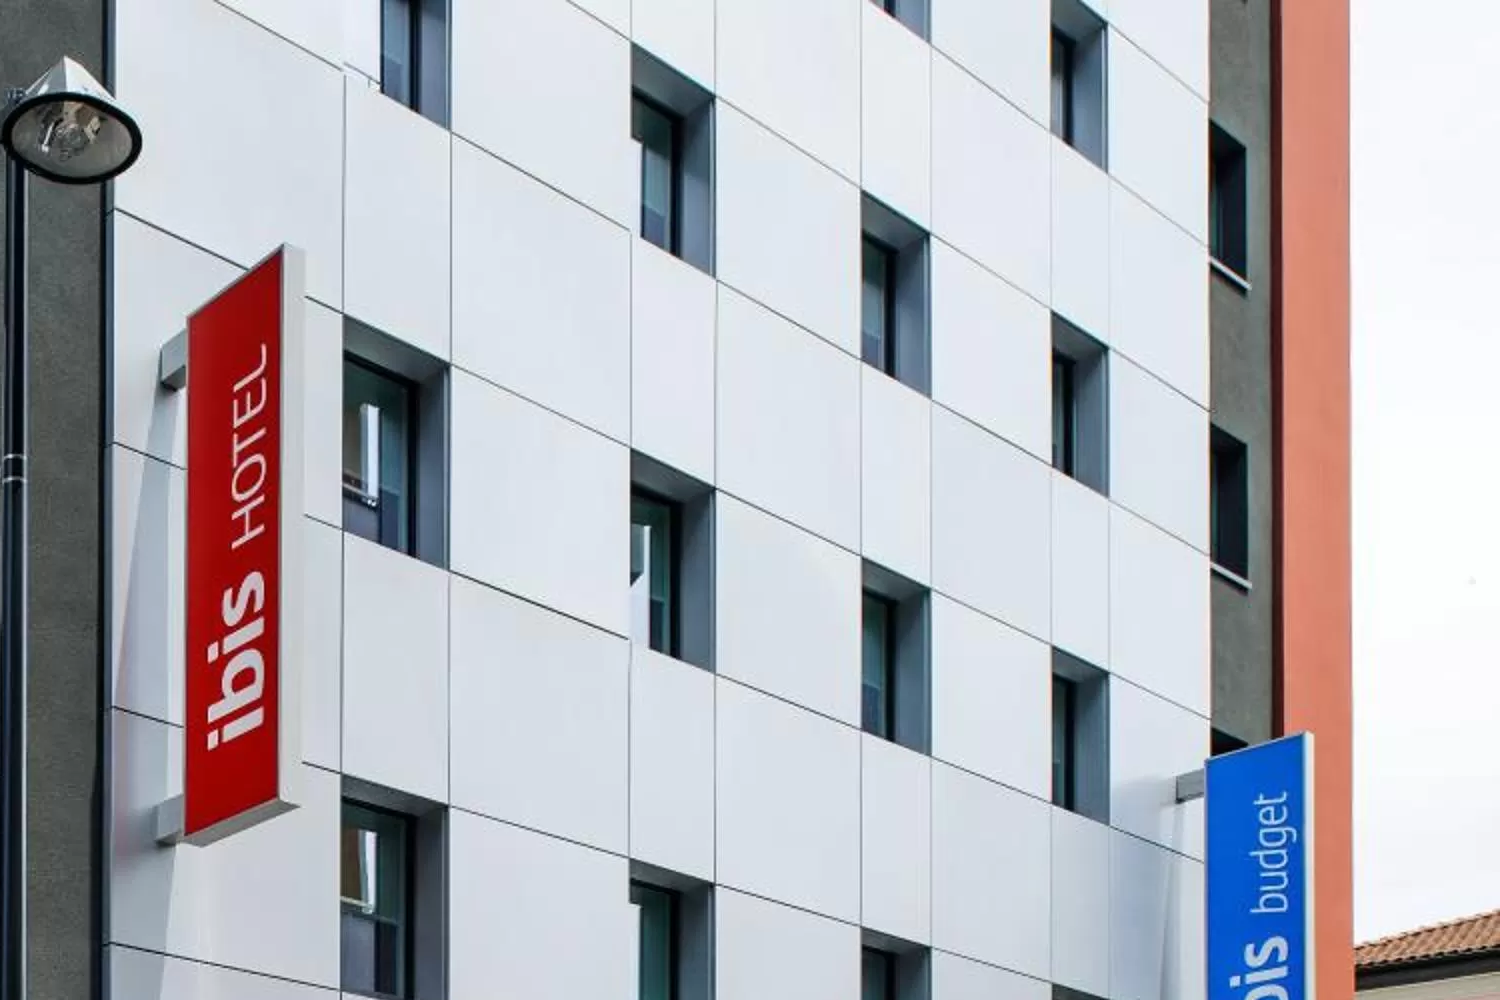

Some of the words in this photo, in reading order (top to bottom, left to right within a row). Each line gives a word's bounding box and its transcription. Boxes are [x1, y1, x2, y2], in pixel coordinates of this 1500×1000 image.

[231, 343, 267, 552] HOTEL
[207, 570, 265, 750] ibis
[1250, 791, 1297, 914] budget
